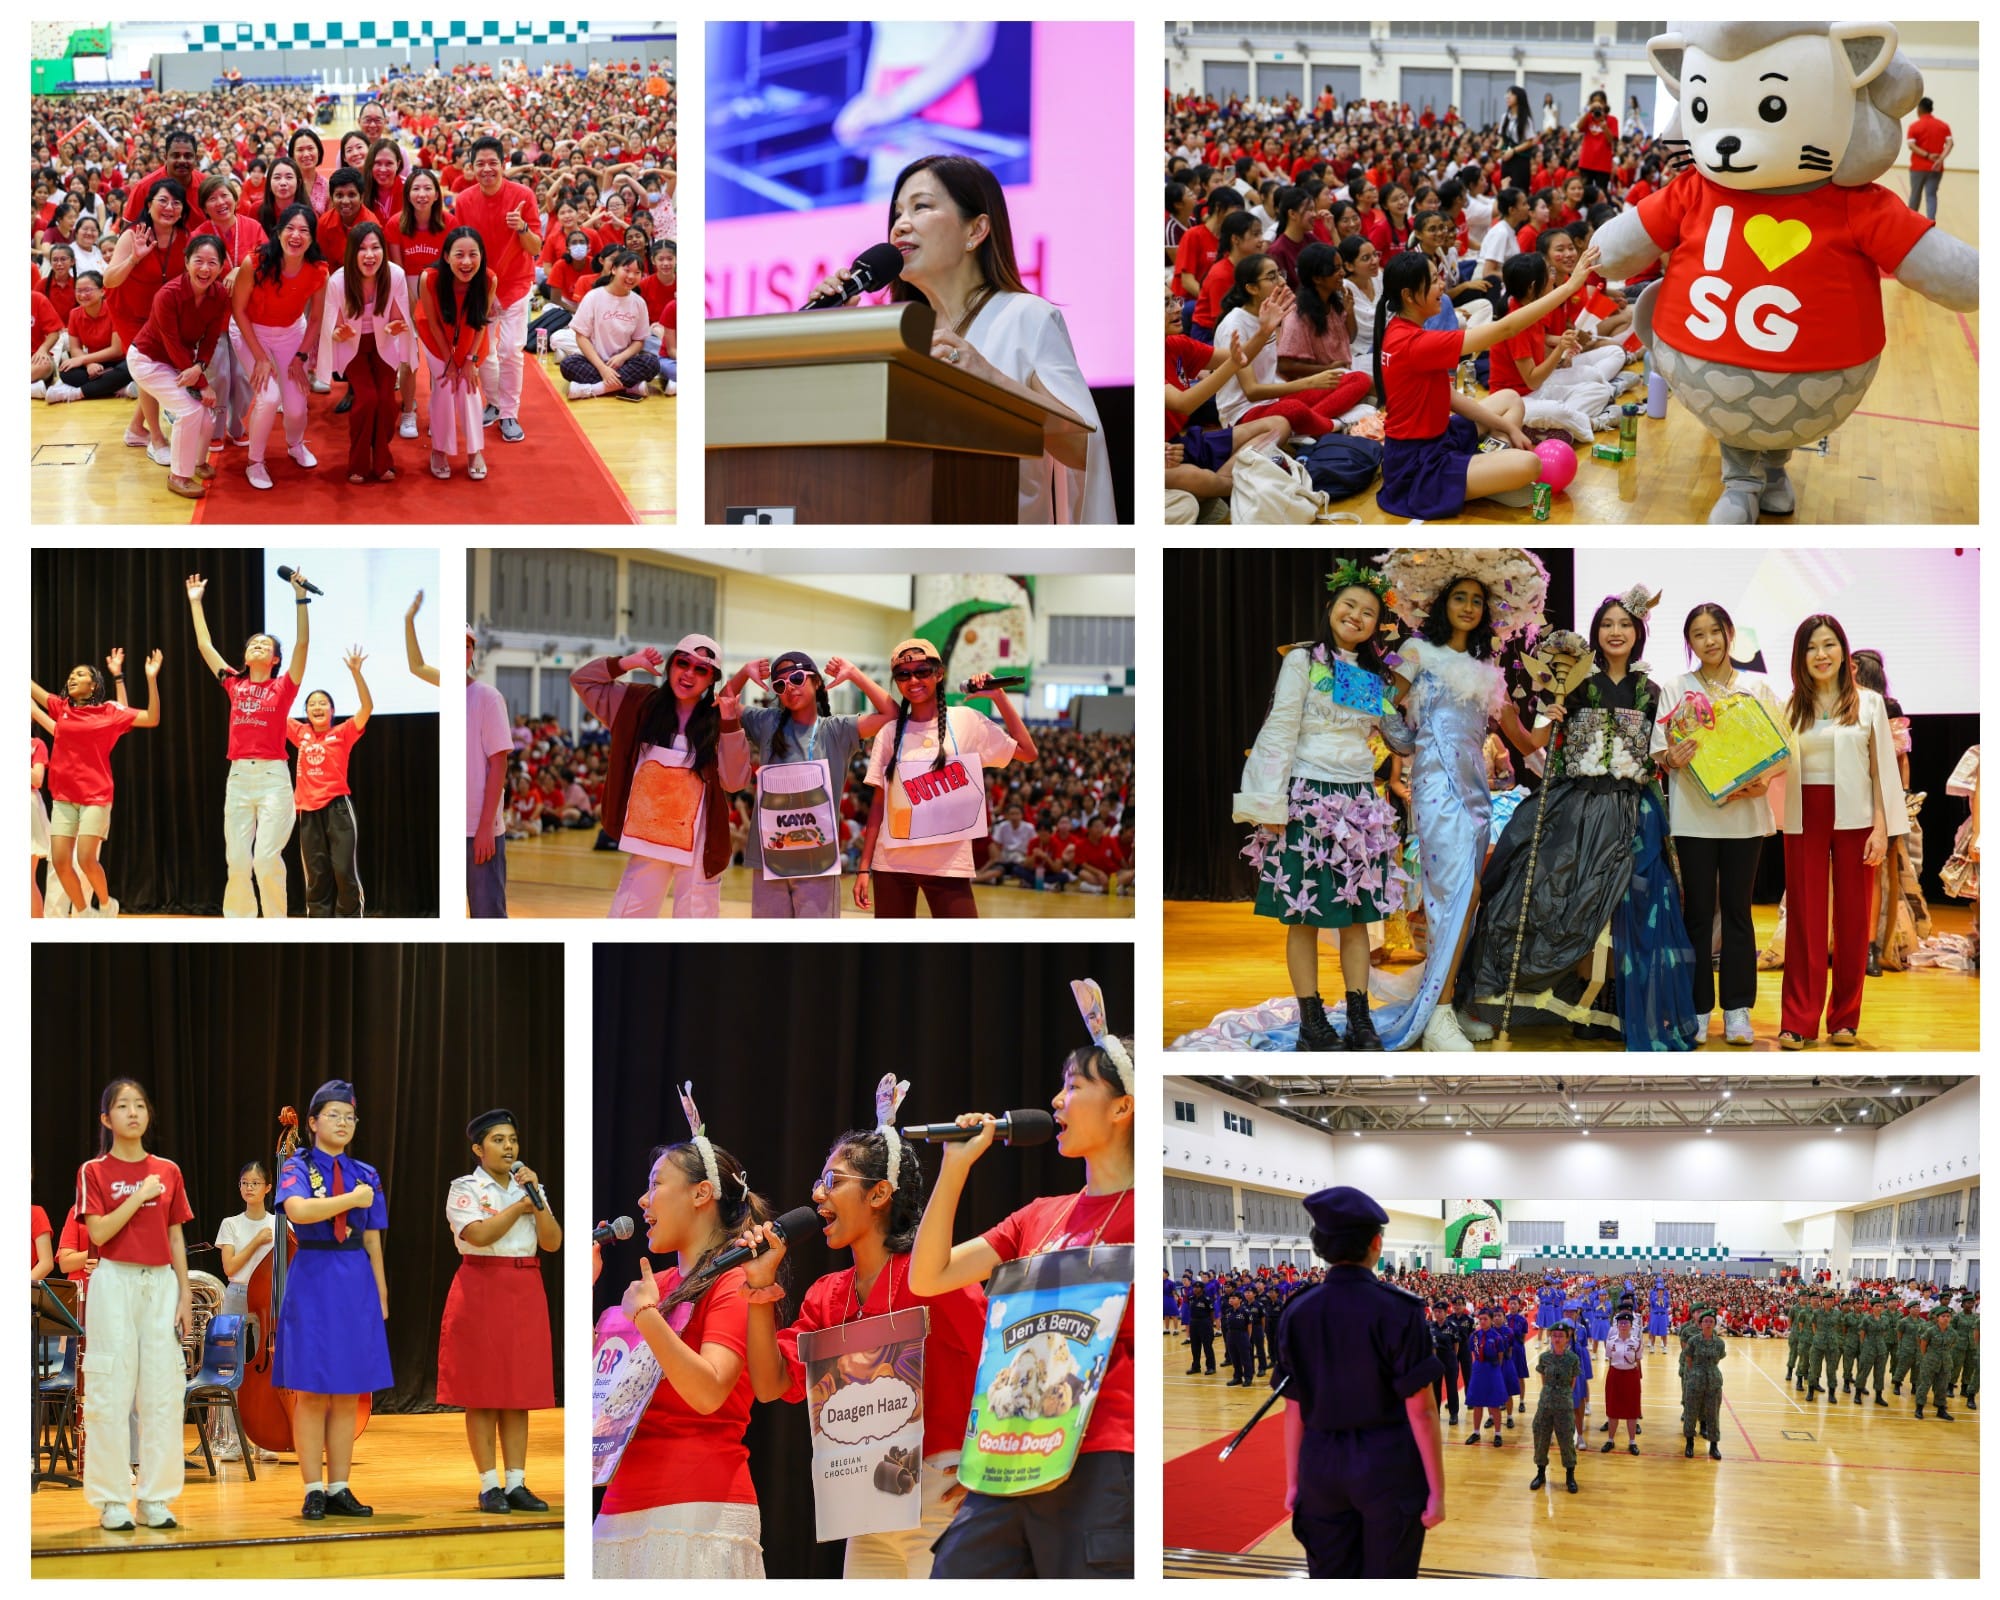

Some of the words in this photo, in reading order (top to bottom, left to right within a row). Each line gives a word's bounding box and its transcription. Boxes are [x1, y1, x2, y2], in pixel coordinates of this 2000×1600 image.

[404, 243, 439, 256] sublime
[1703, 205, 1734, 271] I
[1685, 275, 1802, 352] SG
[903, 761, 969, 806] BUTTER
[776, 813, 817, 828] KAYA
[1008, 1322, 1034, 1344] Jen
[1036, 1316, 1048, 1332] &
[1049, 1314, 1091, 1338] Berrys
[827, 1403, 874, 1423] Daagen
[877, 1396, 908, 1414] Haaz
[979, 1432, 1020, 1452] Cookie
[1021, 1430, 1063, 1453] Dough
[824, 1465, 868, 1479] CHOCOLATE
[830, 1456, 862, 1468] BELGIAN
